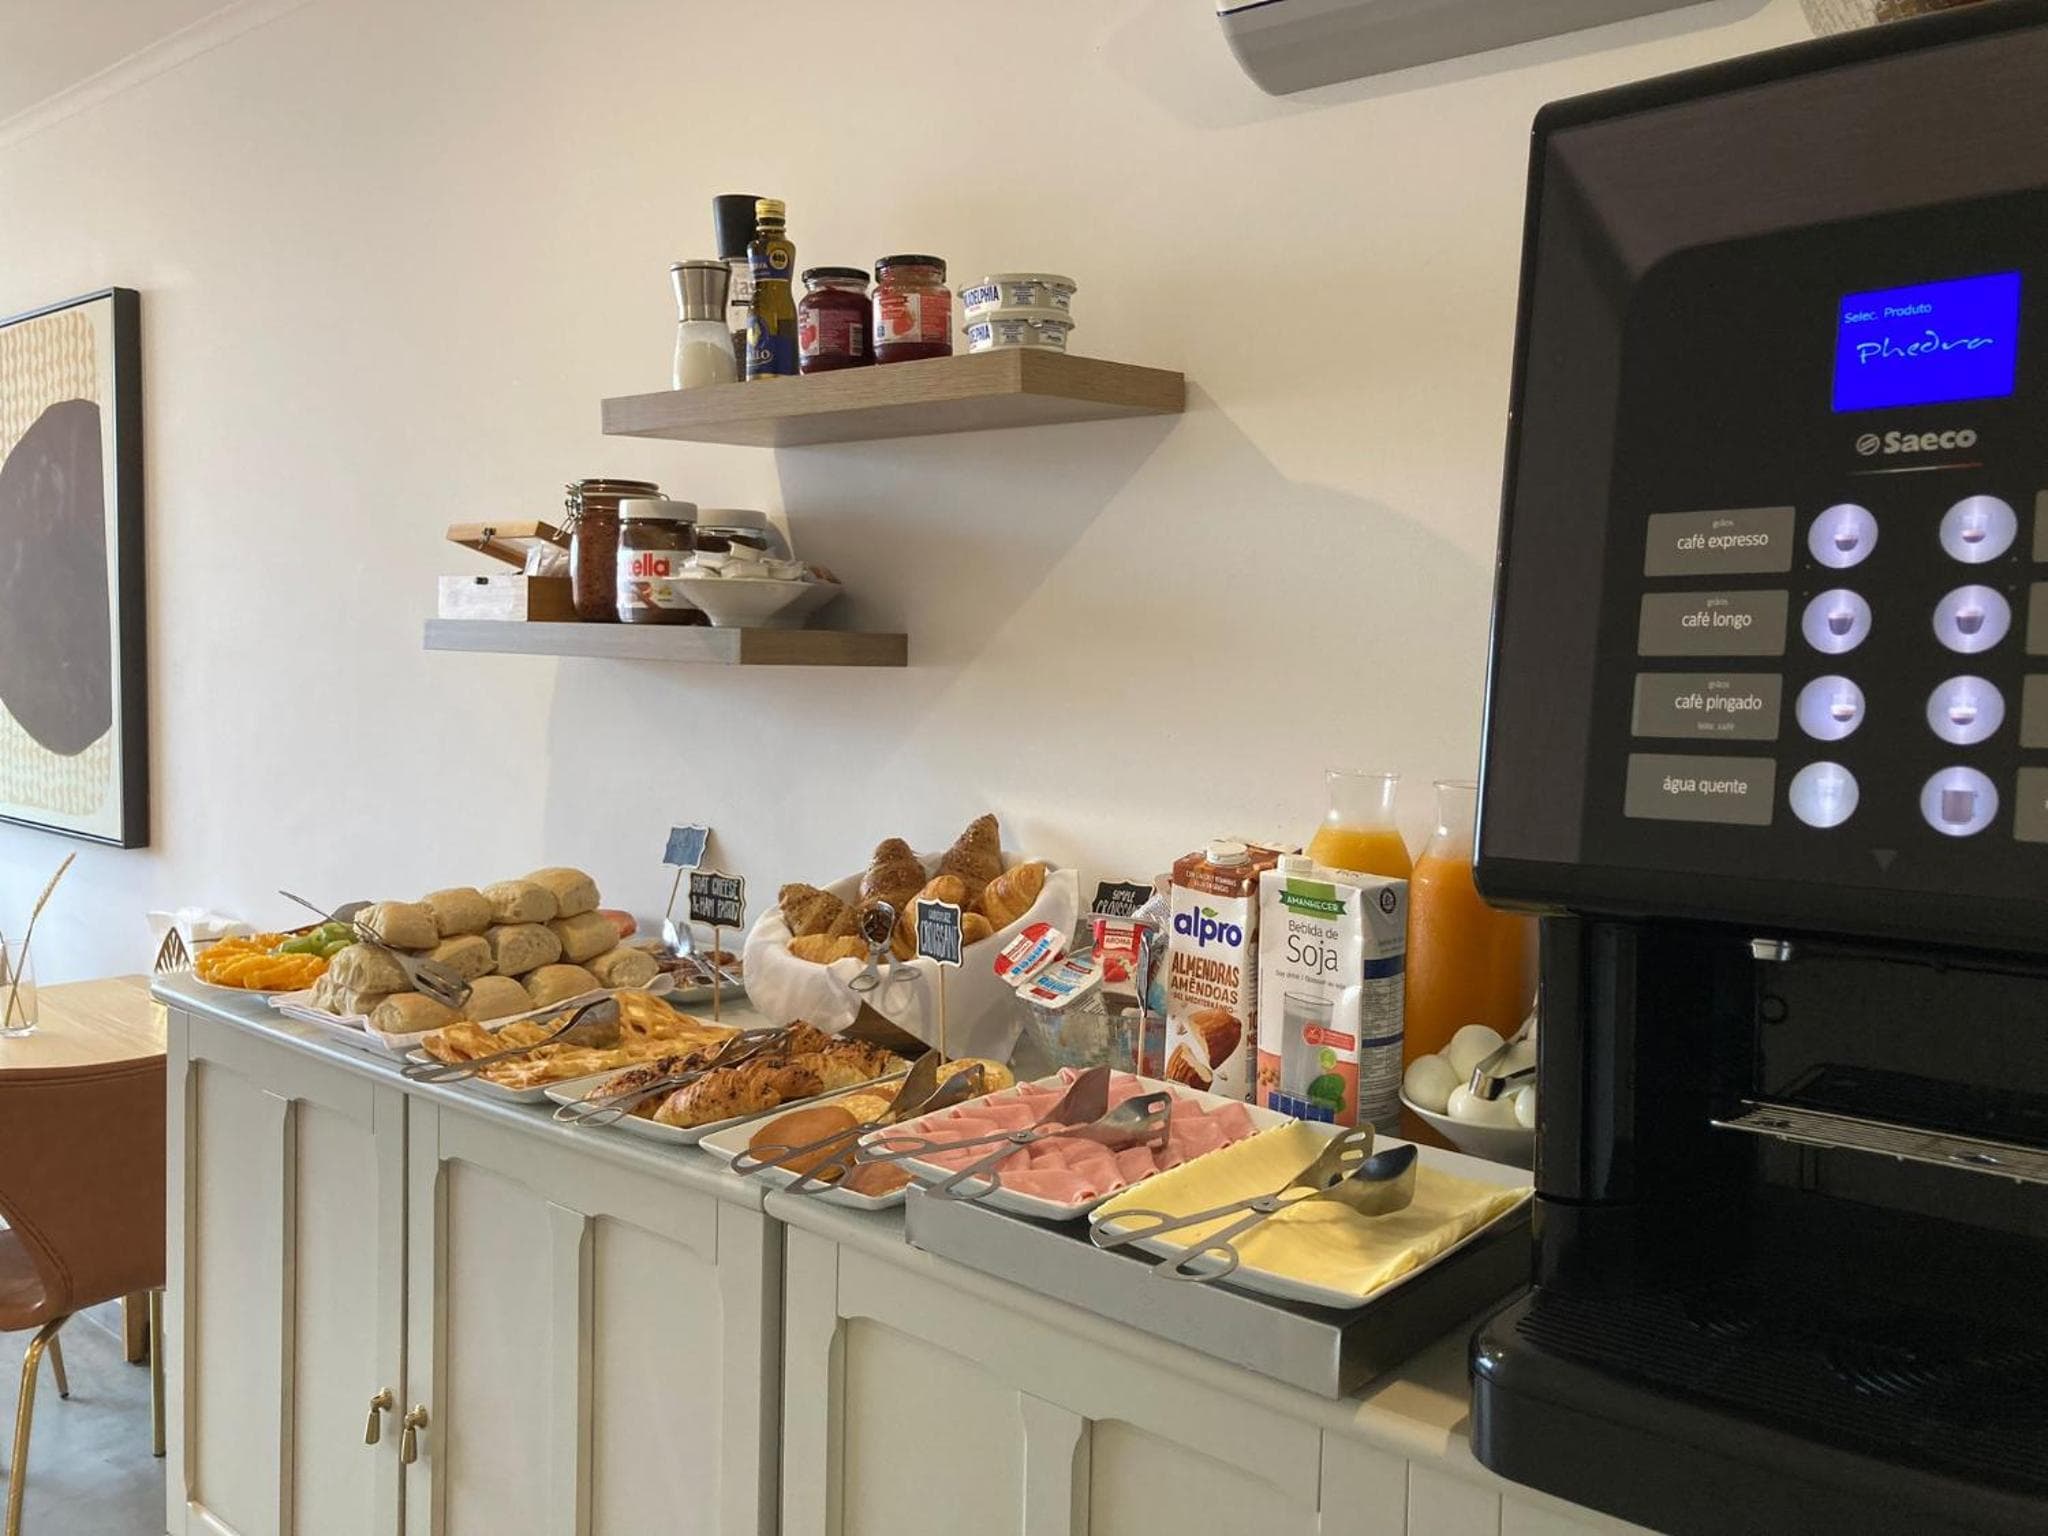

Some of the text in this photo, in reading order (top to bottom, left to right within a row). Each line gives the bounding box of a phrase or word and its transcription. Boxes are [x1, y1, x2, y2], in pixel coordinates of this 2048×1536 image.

[1884, 303, 1932, 318] Produto
[1884, 429, 1978, 454] Saeco
[1677, 533, 1769, 550] café expresso
[632, 552, 671, 577] ella
[1681, 611, 1752, 630] café longo
[1675, 693, 1763, 713] café pingado
[1663, 775, 1748, 795] água quente
[1286, 895, 1339, 912] AMANHECER
[1174, 906, 1242, 948] alpro
[1288, 919, 1339, 940] Bebida de
[1286, 934, 1339, 975] Soja
[1171, 951, 1240, 988] ALMENDRAS
[1170, 975, 1239, 1005] AMÊNDOAS
